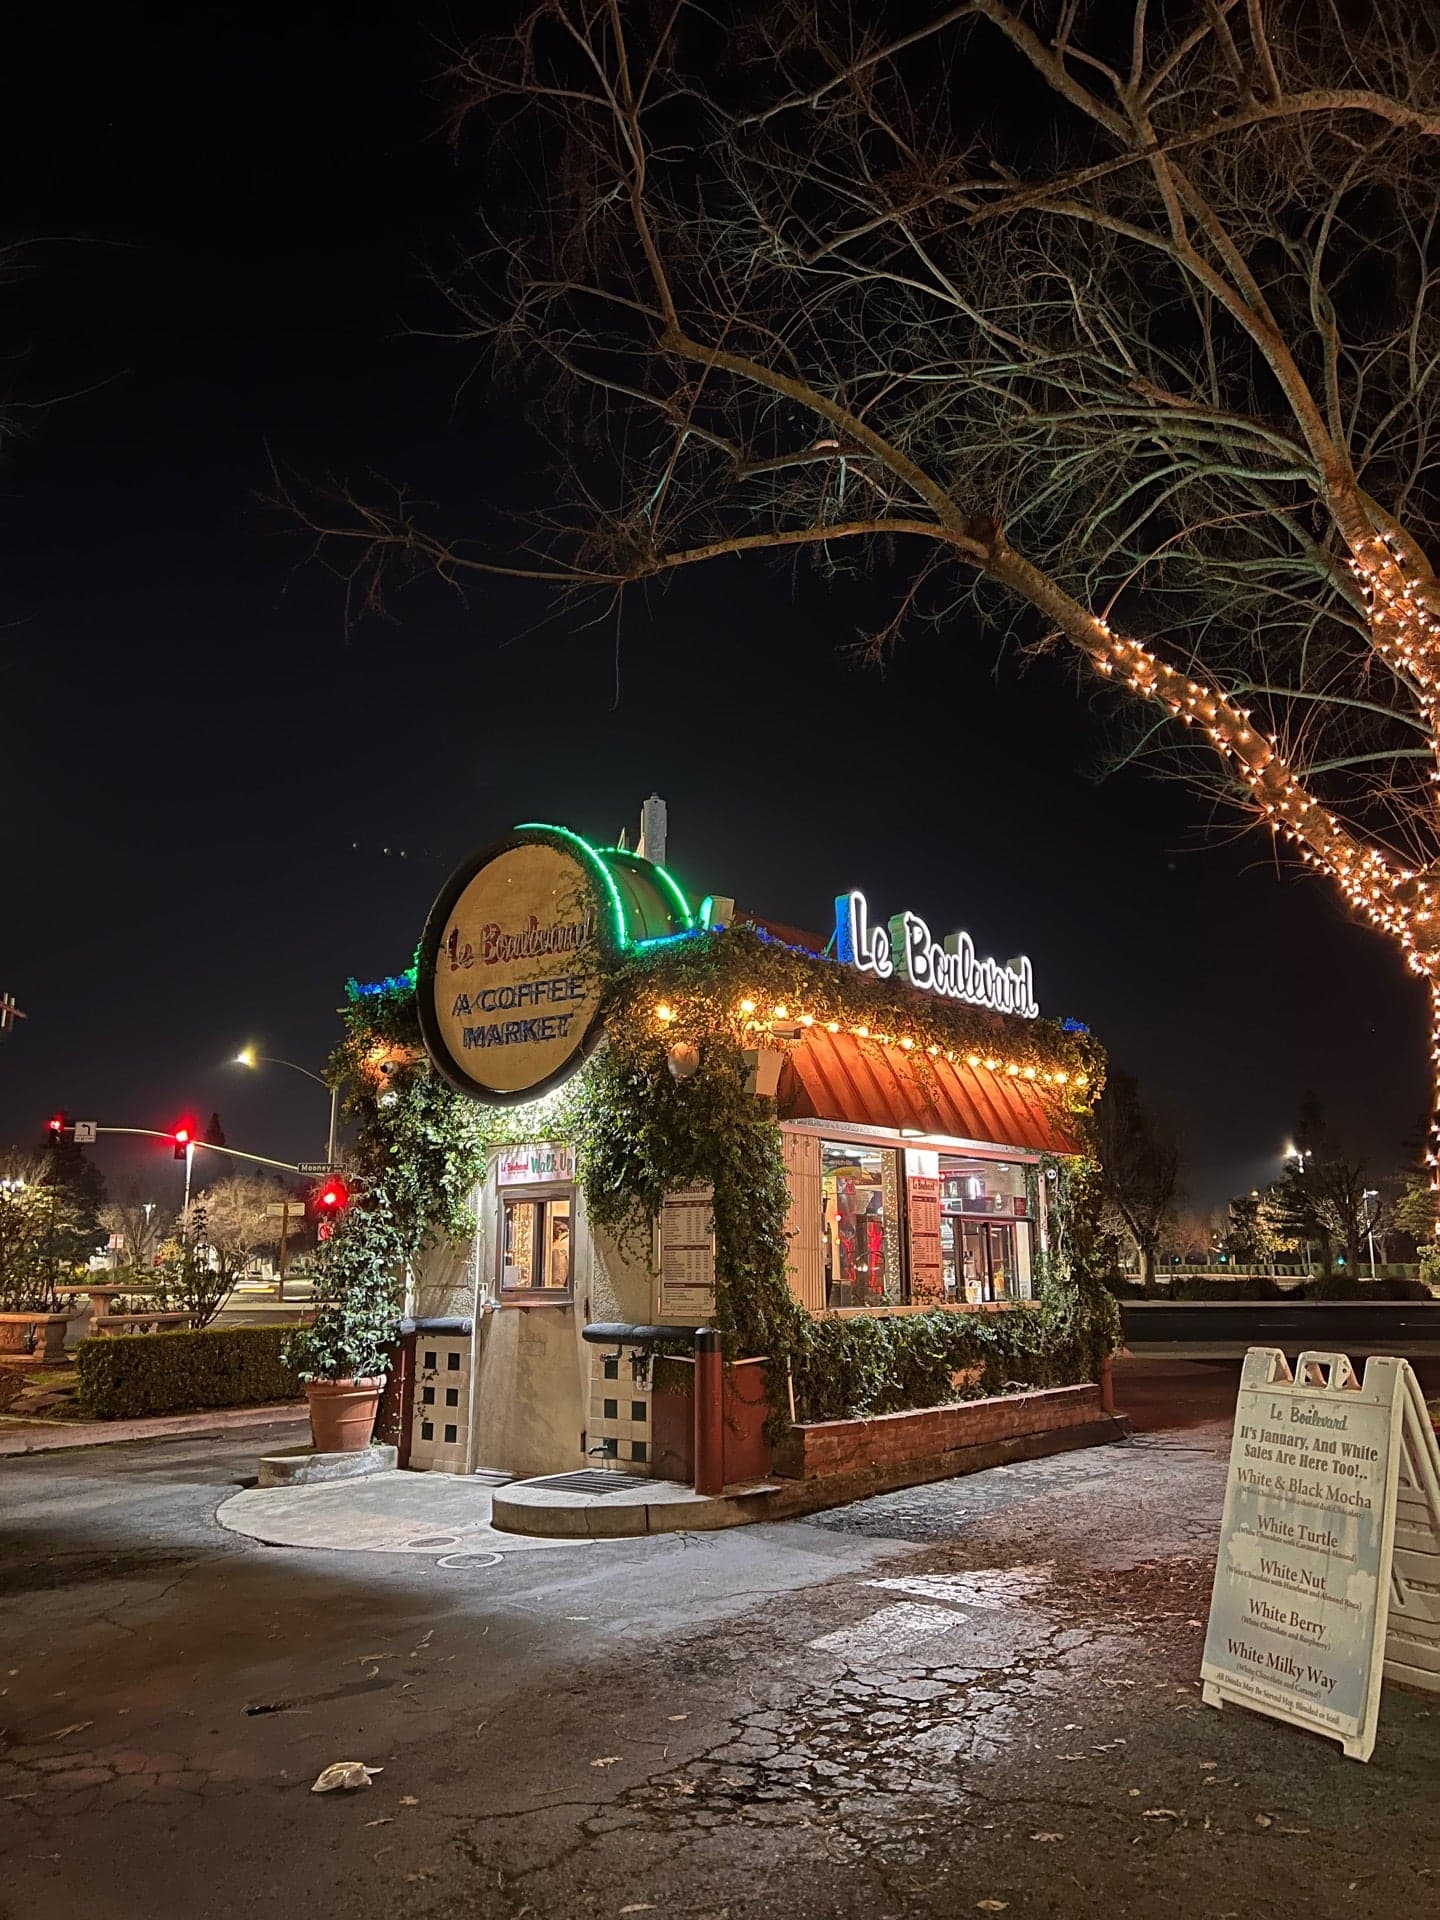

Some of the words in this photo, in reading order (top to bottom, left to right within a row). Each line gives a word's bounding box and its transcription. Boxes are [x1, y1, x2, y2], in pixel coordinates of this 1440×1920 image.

[846, 890, 893, 978] Le
[902, 911, 1040, 1018] Boulevard
[452, 993, 472, 1017] A
[476, 975, 586, 1012] COFFEE
[463, 1013, 573, 1049] MARKET
[301, 1164, 331, 1172] Mooney
[531, 1153, 559, 1173] Walk
[559, 1151, 572, 1176] Up
[1270, 1403, 1284, 1421] Le
[1290, 1406, 1348, 1431] Boulevard
[1240, 1425, 1257, 1440] It's
[1259, 1428, 1309, 1451] January,
[1312, 1438, 1337, 1454] And
[1341, 1442, 1378, 1462] White
[1244, 1443, 1273, 1461] Sales
[1275, 1450, 1296, 1466] Are
[1299, 1453, 1328, 1472] Here
[1237, 1467, 1272, 1488] White
[1274, 1475, 1285, 1490] &
[1288, 1478, 1324, 1499] Black
[1325, 1485, 1372, 1509] Mocha
[1257, 1514, 1295, 1538] White
[1297, 1524, 1339, 1548] Turtle
[1260, 1558, 1297, 1582] White
[1299, 1569, 1328, 1590] Nut
[1249, 1599, 1286, 1623] White
[1289, 1611, 1328, 1640] Berry
[1228, 1638, 1264, 1664] White
[1267, 1652, 1305, 1683] Milky
[1307, 1665, 1338, 1694] Way
